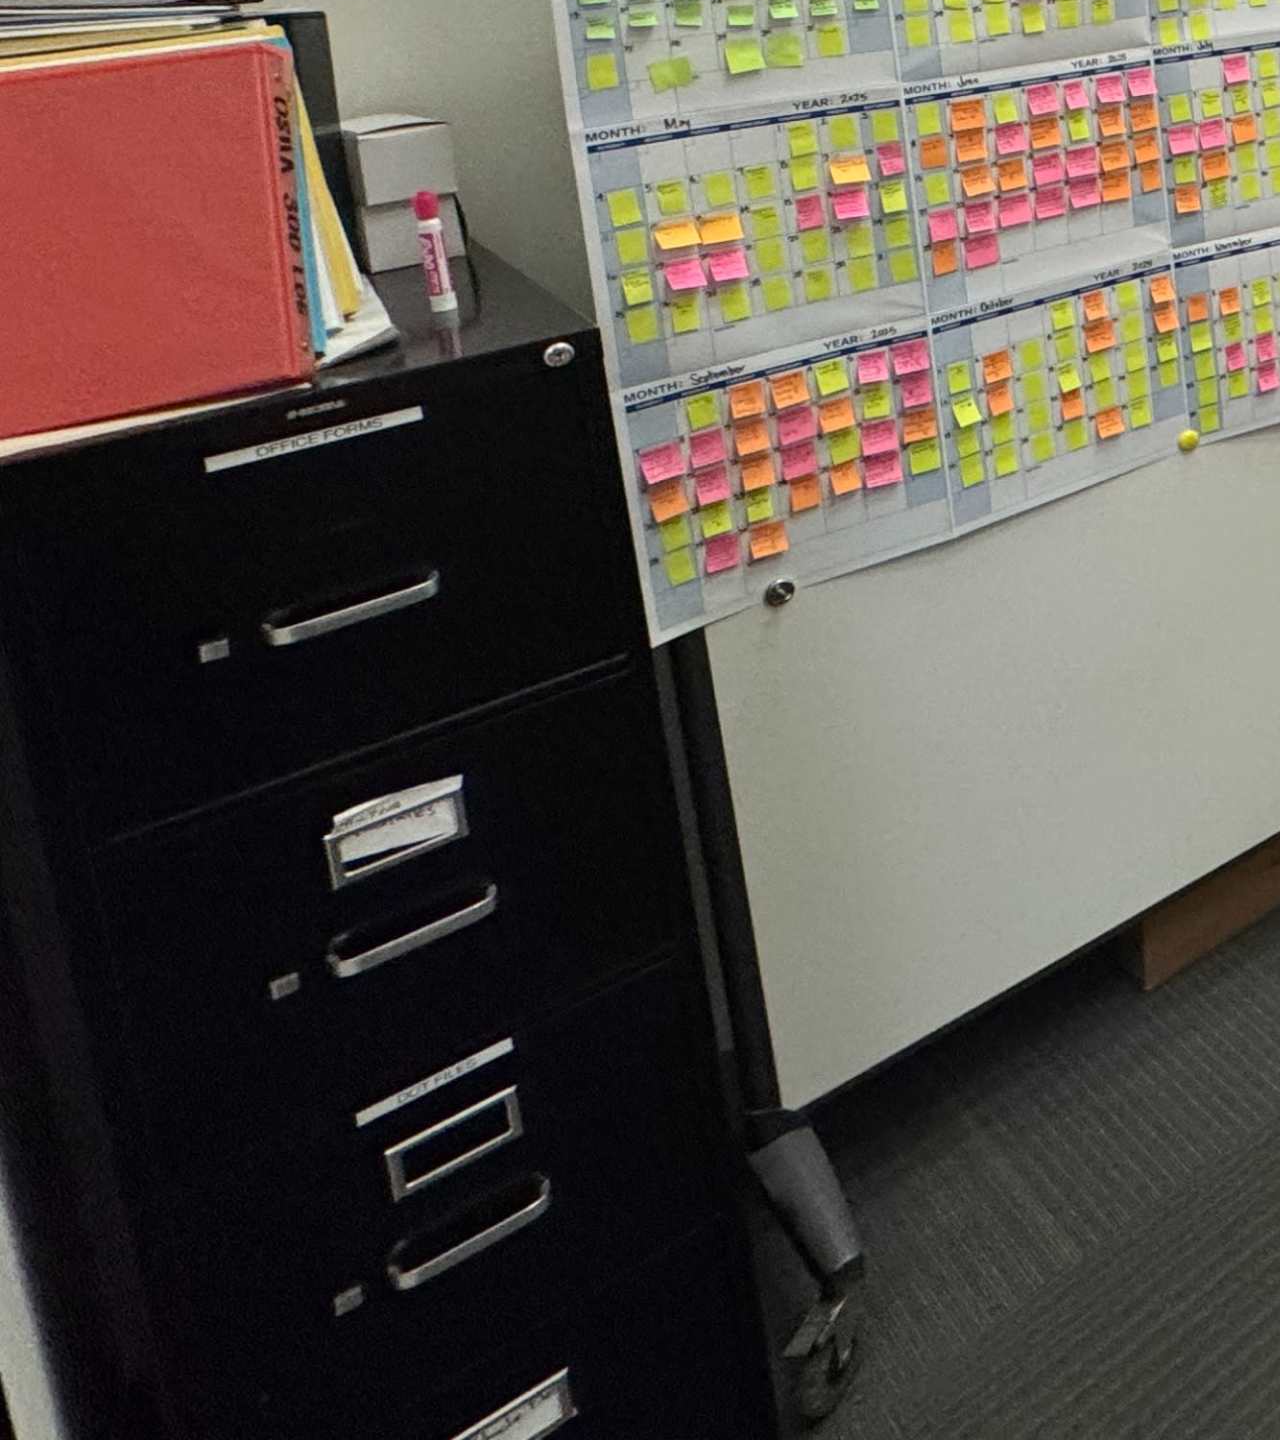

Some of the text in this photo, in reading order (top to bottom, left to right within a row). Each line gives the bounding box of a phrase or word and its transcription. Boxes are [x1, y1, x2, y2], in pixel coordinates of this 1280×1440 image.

[1153, 43, 1192, 56] MONTH:
[904, 81, 950, 95] MONTH:
[585, 125, 646, 143] MONTH:
[664, 118, 691, 132] May
[793, 98, 833, 110] YEAR:
[931, 307, 977, 325] MONTH:
[624, 382, 684, 403] MONTH:
[690, 364, 746, 384] September
[823, 335, 864, 351] YEAR:
[255, 418, 382, 458] OFFICE FORMS
